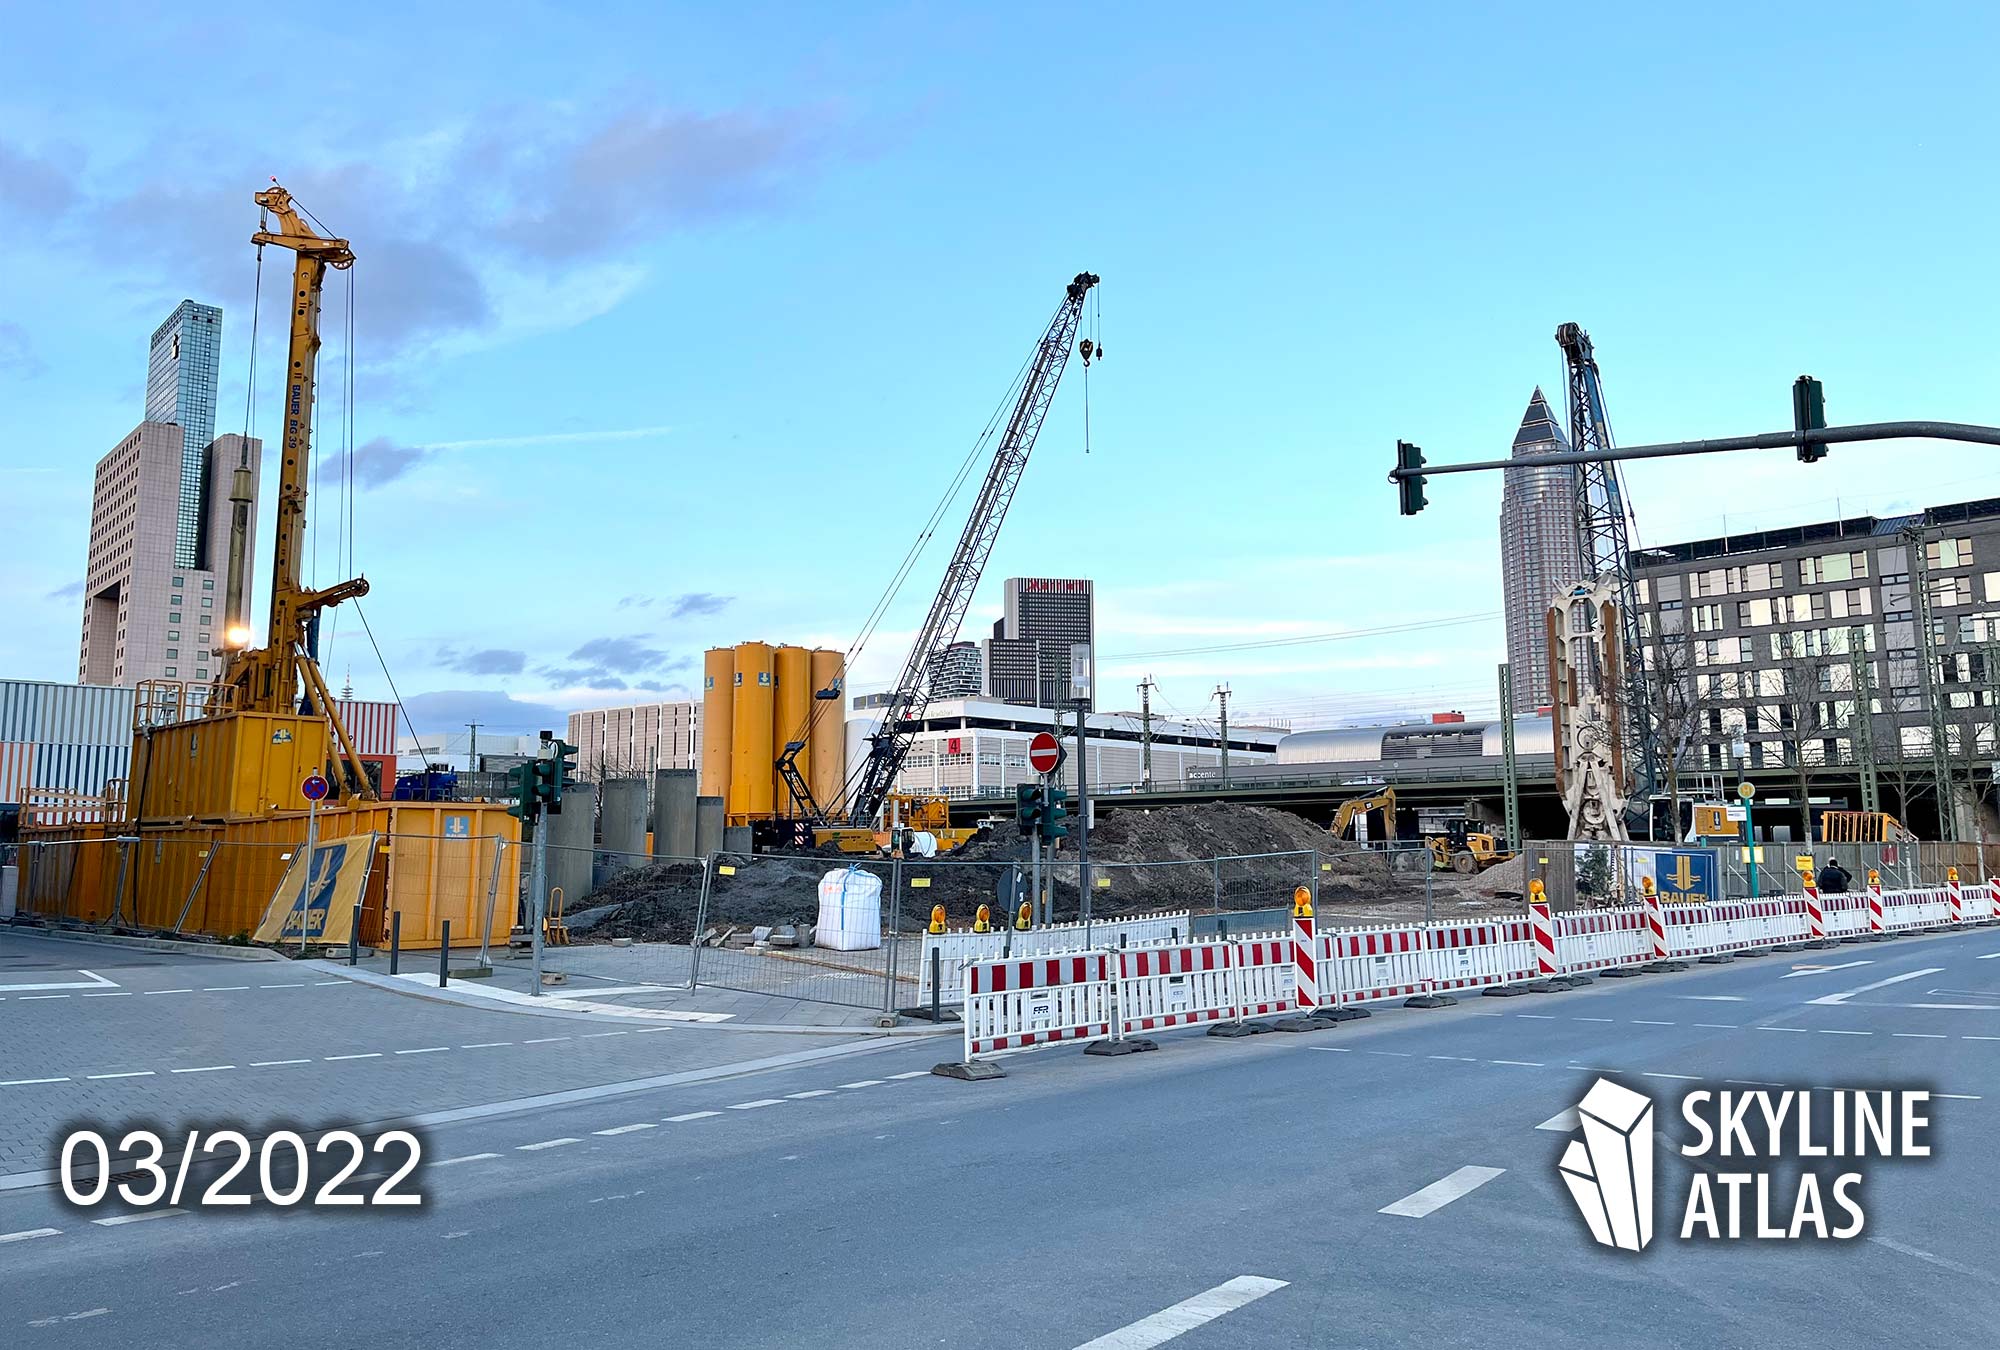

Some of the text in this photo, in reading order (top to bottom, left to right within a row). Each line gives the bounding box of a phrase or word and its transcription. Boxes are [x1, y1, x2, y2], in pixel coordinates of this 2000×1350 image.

[288, 384, 301, 449] BAUER BG 39
[1660, 891, 1709, 904] BAUER
